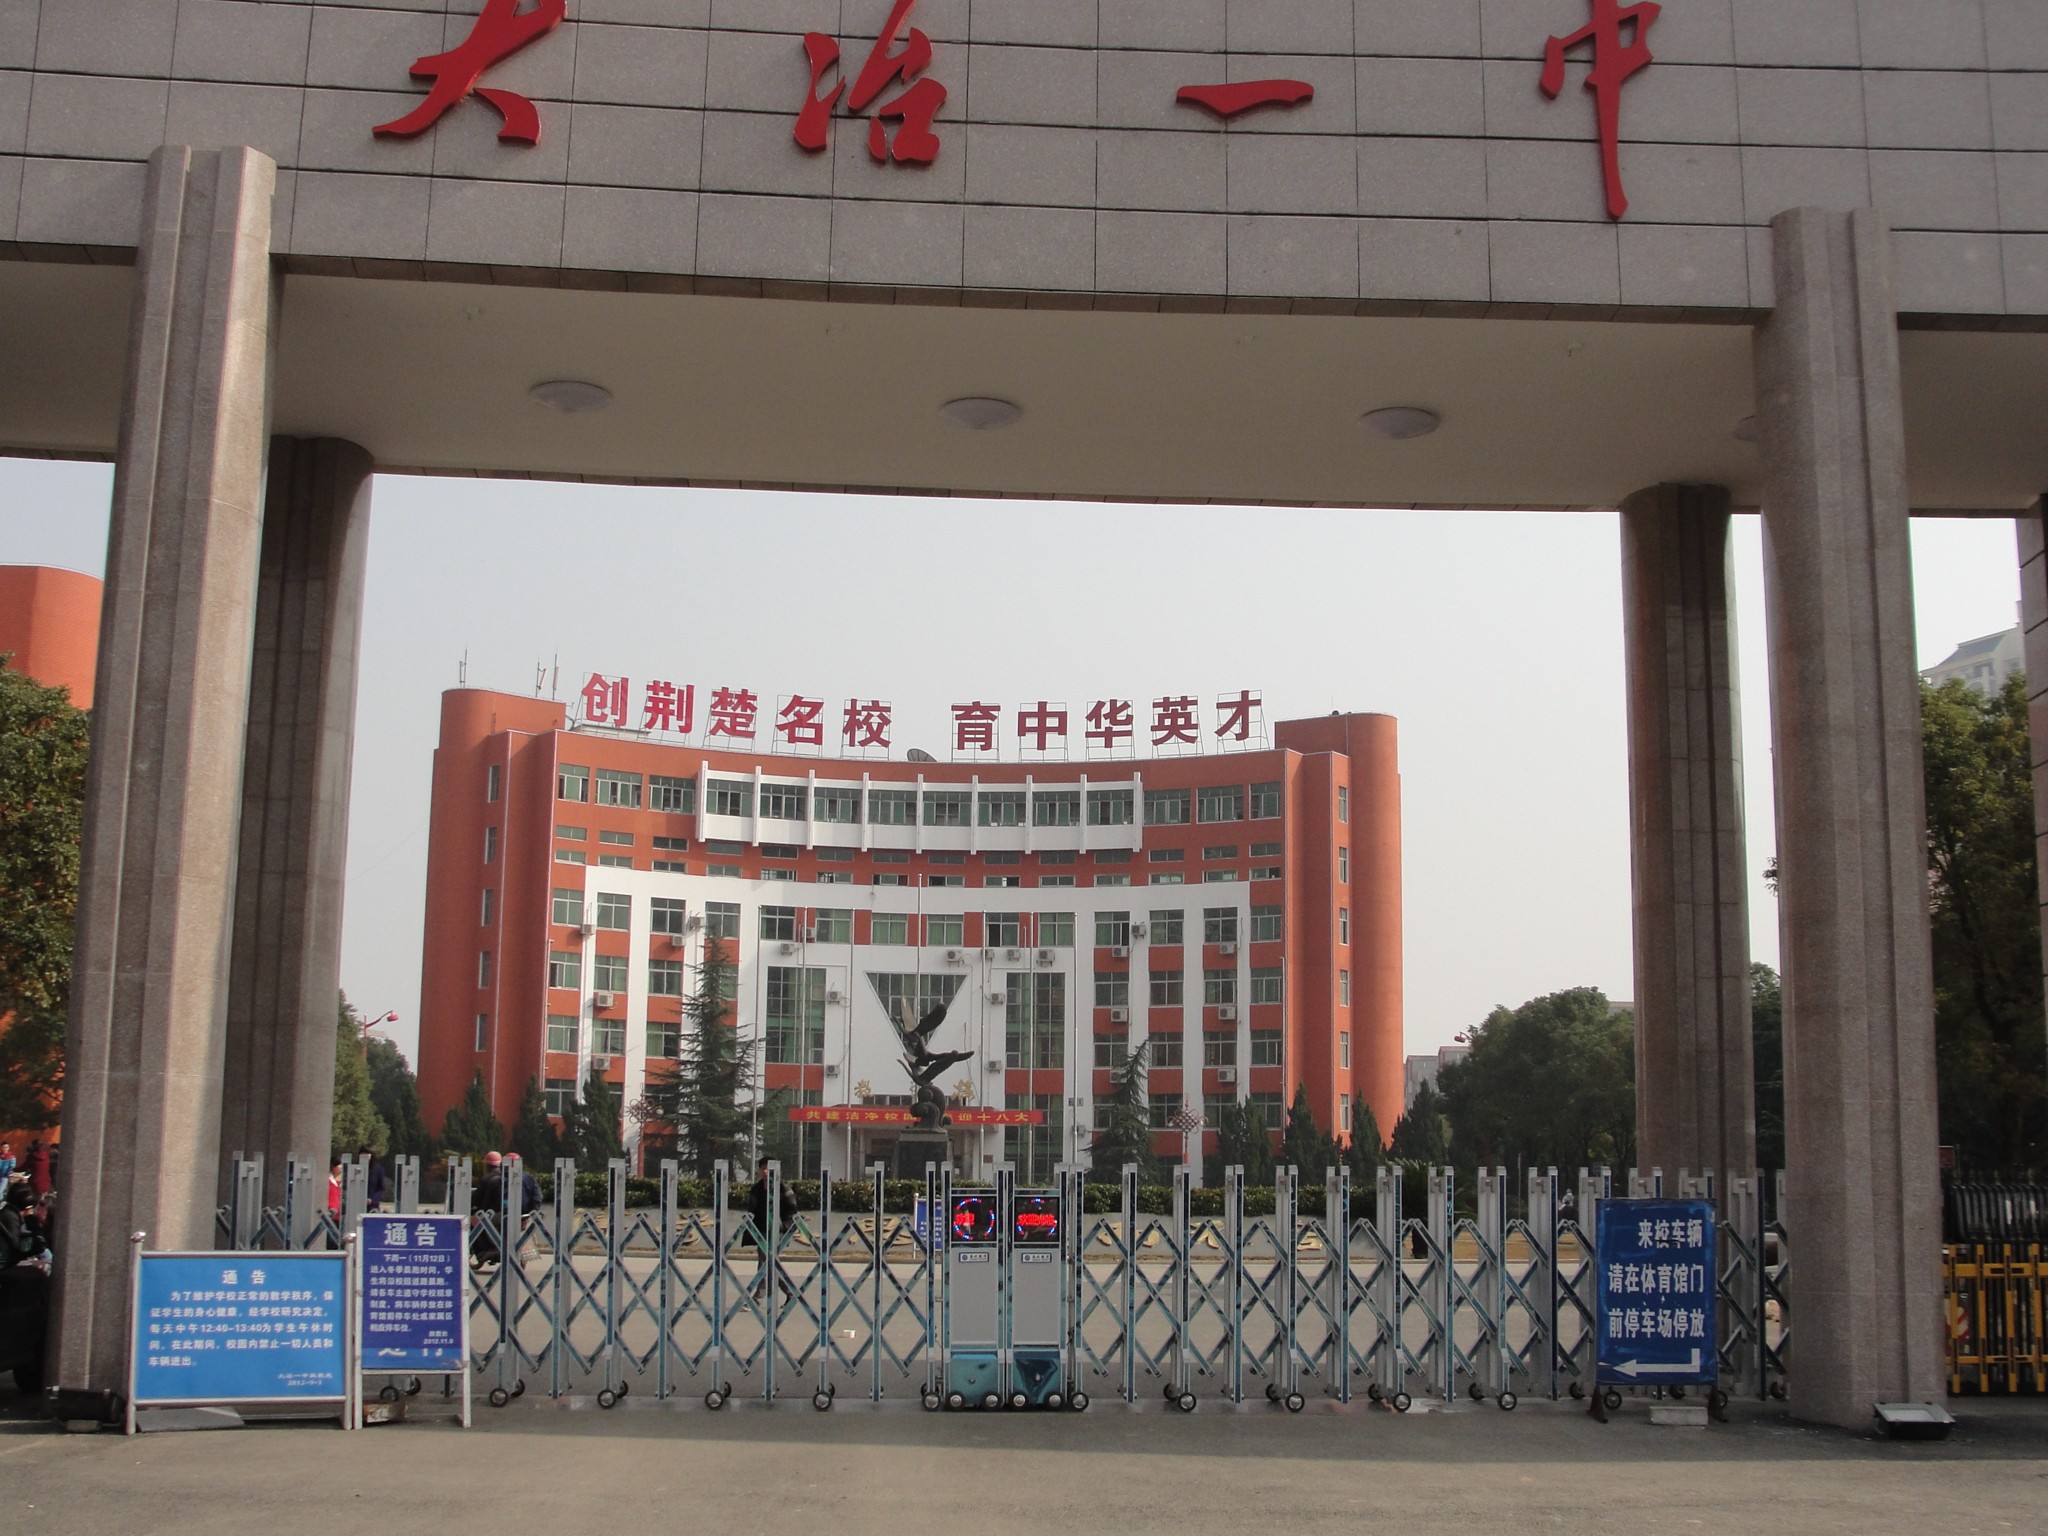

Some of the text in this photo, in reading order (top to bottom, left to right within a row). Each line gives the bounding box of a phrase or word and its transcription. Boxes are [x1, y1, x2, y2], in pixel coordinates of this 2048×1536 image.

[582, 672, 1262, 751] 创荆楚名校 育中华英才
[384, 1222, 438, 1246] 通告
[1638, 1219, 1703, 1248] 来校车辆
[222, 1269, 267, 1285] 通告
[1608, 1262, 1704, 1294] 请在体育馆门
[1608, 1308, 1705, 1339] 前停车场停放
